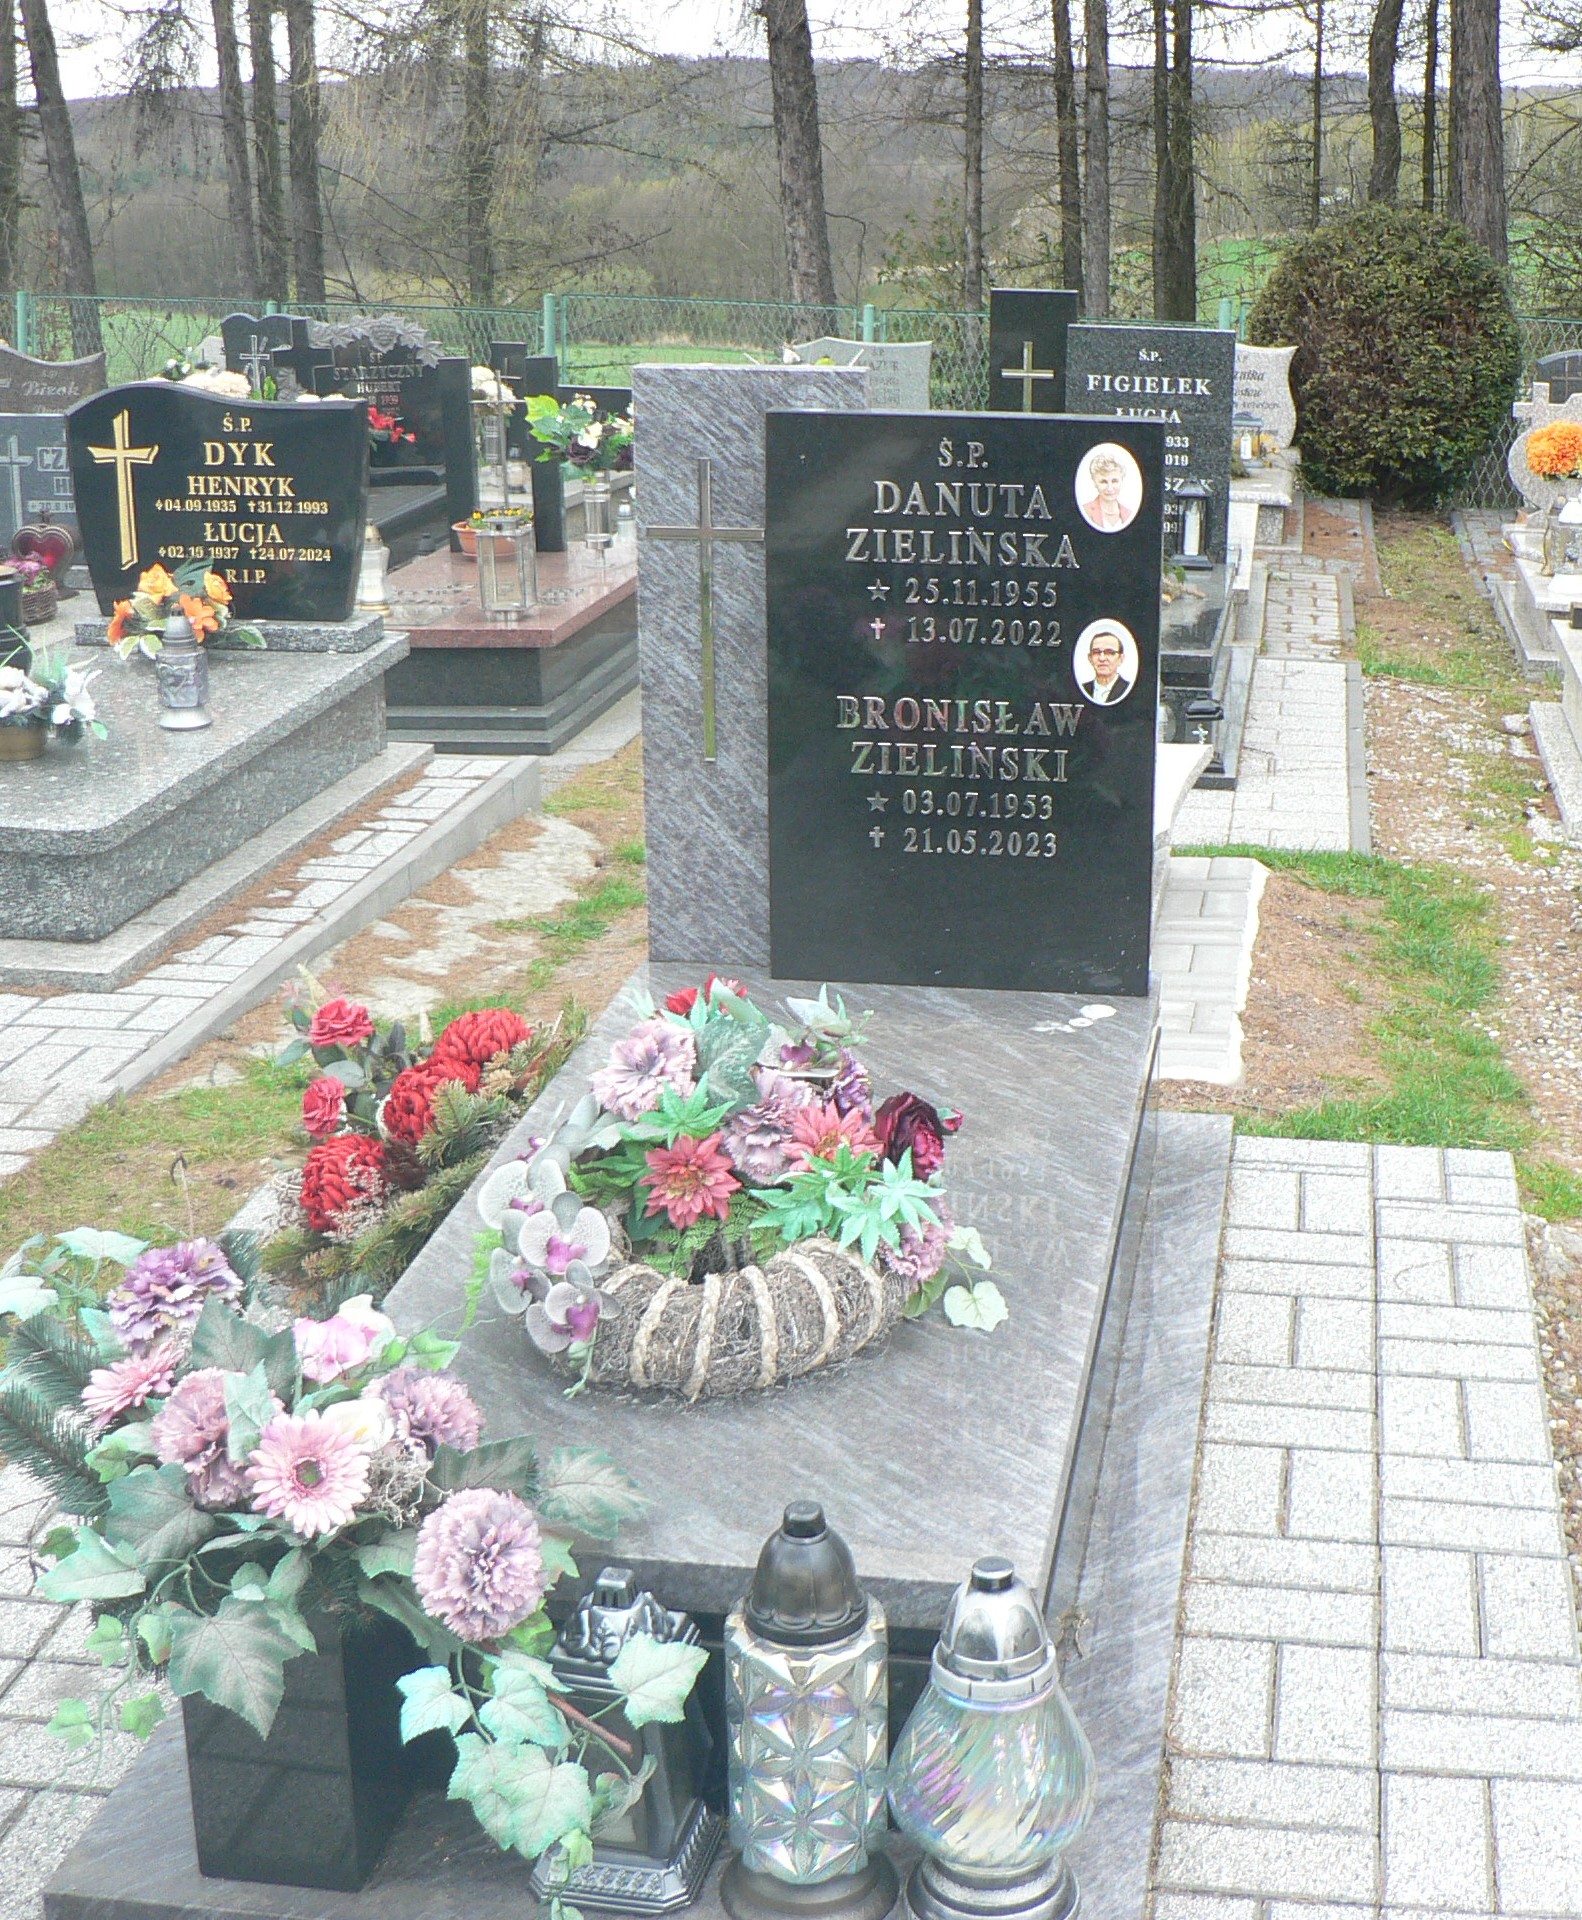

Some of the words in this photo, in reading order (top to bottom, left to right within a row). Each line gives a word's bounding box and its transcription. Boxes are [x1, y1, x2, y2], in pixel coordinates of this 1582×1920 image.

[1086, 374, 1212, 395] FIGIELEK
[222, 412, 253, 432] Ś.P.
[203, 441, 276, 467] DYK
[936, 436, 989, 469] Ś.P.
[187, 475, 296, 497] HENRYK
[873, 479, 1053, 521] DANUTA
[164, 499, 237, 513] 04.09.1935
[257, 500, 329, 515] 31.12.1993
[203, 522, 285, 548] ŁUCJA
[844, 526, 1081, 570] ZIELIŃSKA
[259, 547, 332, 562] 24.07.2024
[225, 568, 267, 584] R.I.P.
[904, 577, 1058, 608] 25.11.1955
[906, 616, 1062, 648] 13.07.2022
[836, 694, 1085, 737] BRONISŁAW
[850, 740, 1069, 783] ZIELIŃSKI
[902, 788, 1054, 821] 03.07.1953
[903, 827, 1058, 859] 21.05.2023
